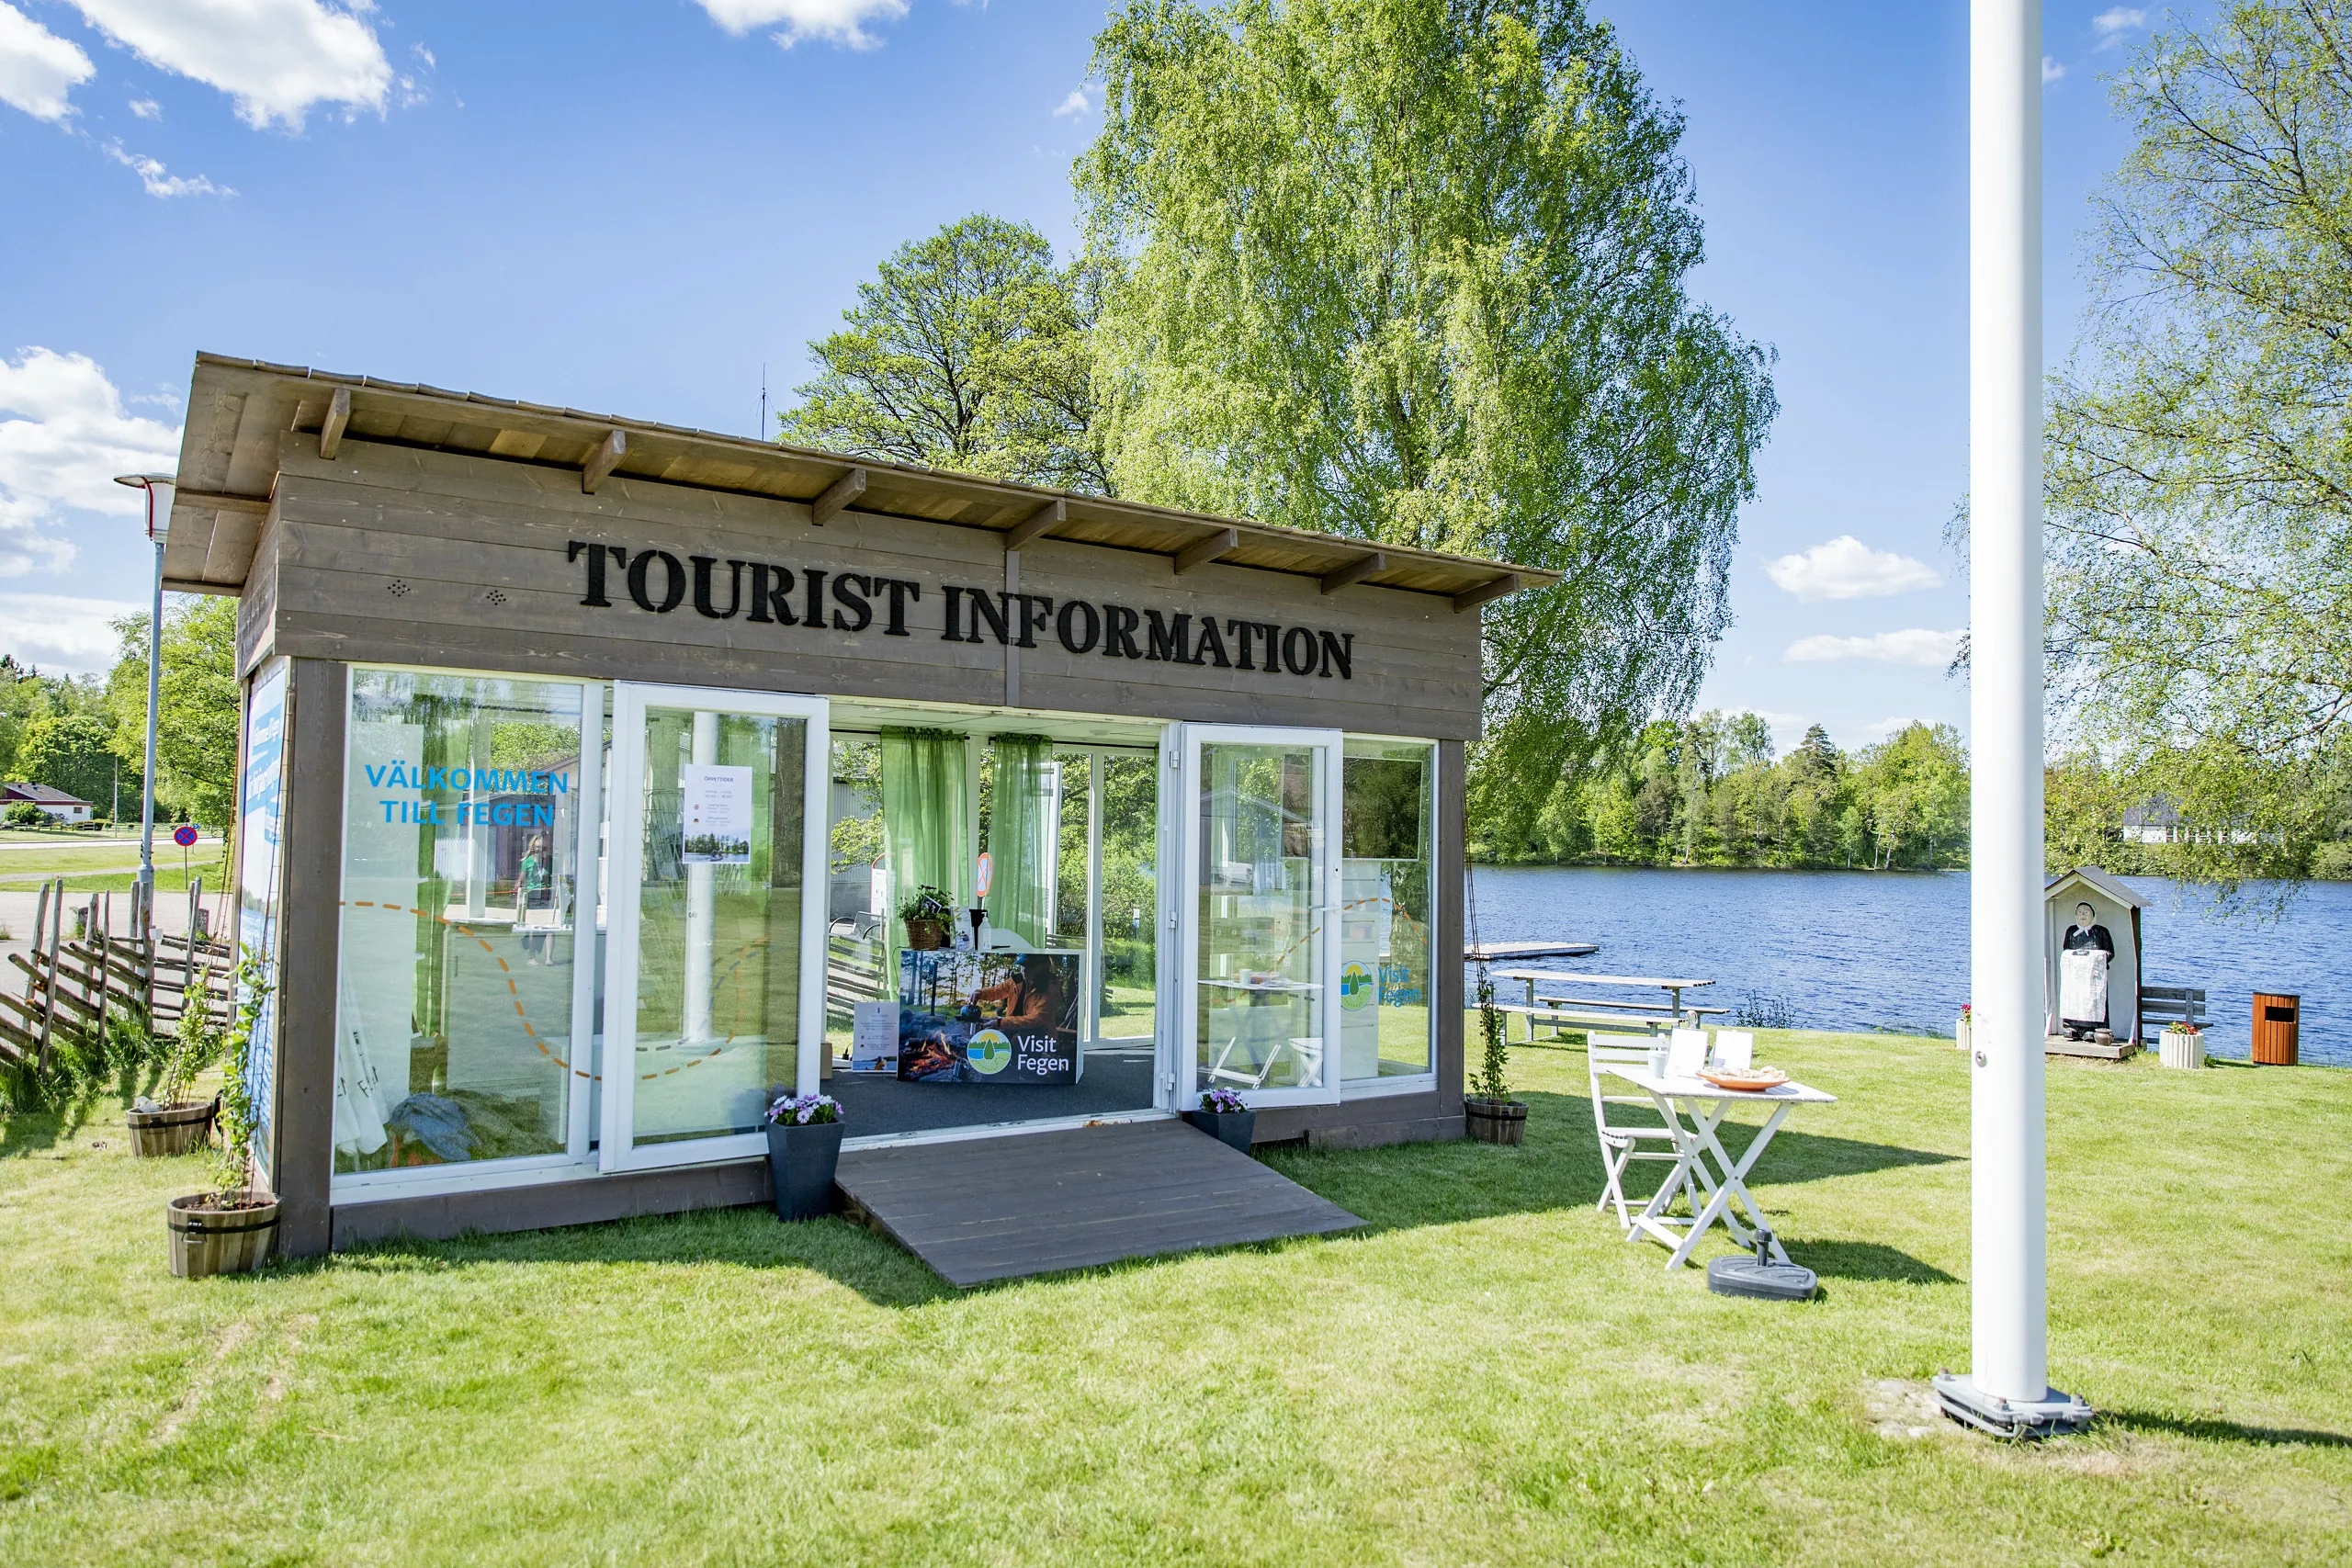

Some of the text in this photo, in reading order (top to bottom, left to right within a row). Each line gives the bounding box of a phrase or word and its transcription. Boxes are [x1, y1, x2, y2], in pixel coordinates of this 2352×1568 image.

[568, 540, 1355, 680] TOURIST INFORMATION
[365, 760, 568, 794] VÄLKOMMEN
[379, 800, 554, 827] TILL FEGEN
[1377, 964, 1410, 984] Visit
[1378, 986, 1421, 1008] Fegen
[1017, 1034, 1057, 1053] Visit
[1017, 1054, 1069, 1076] Fegen
